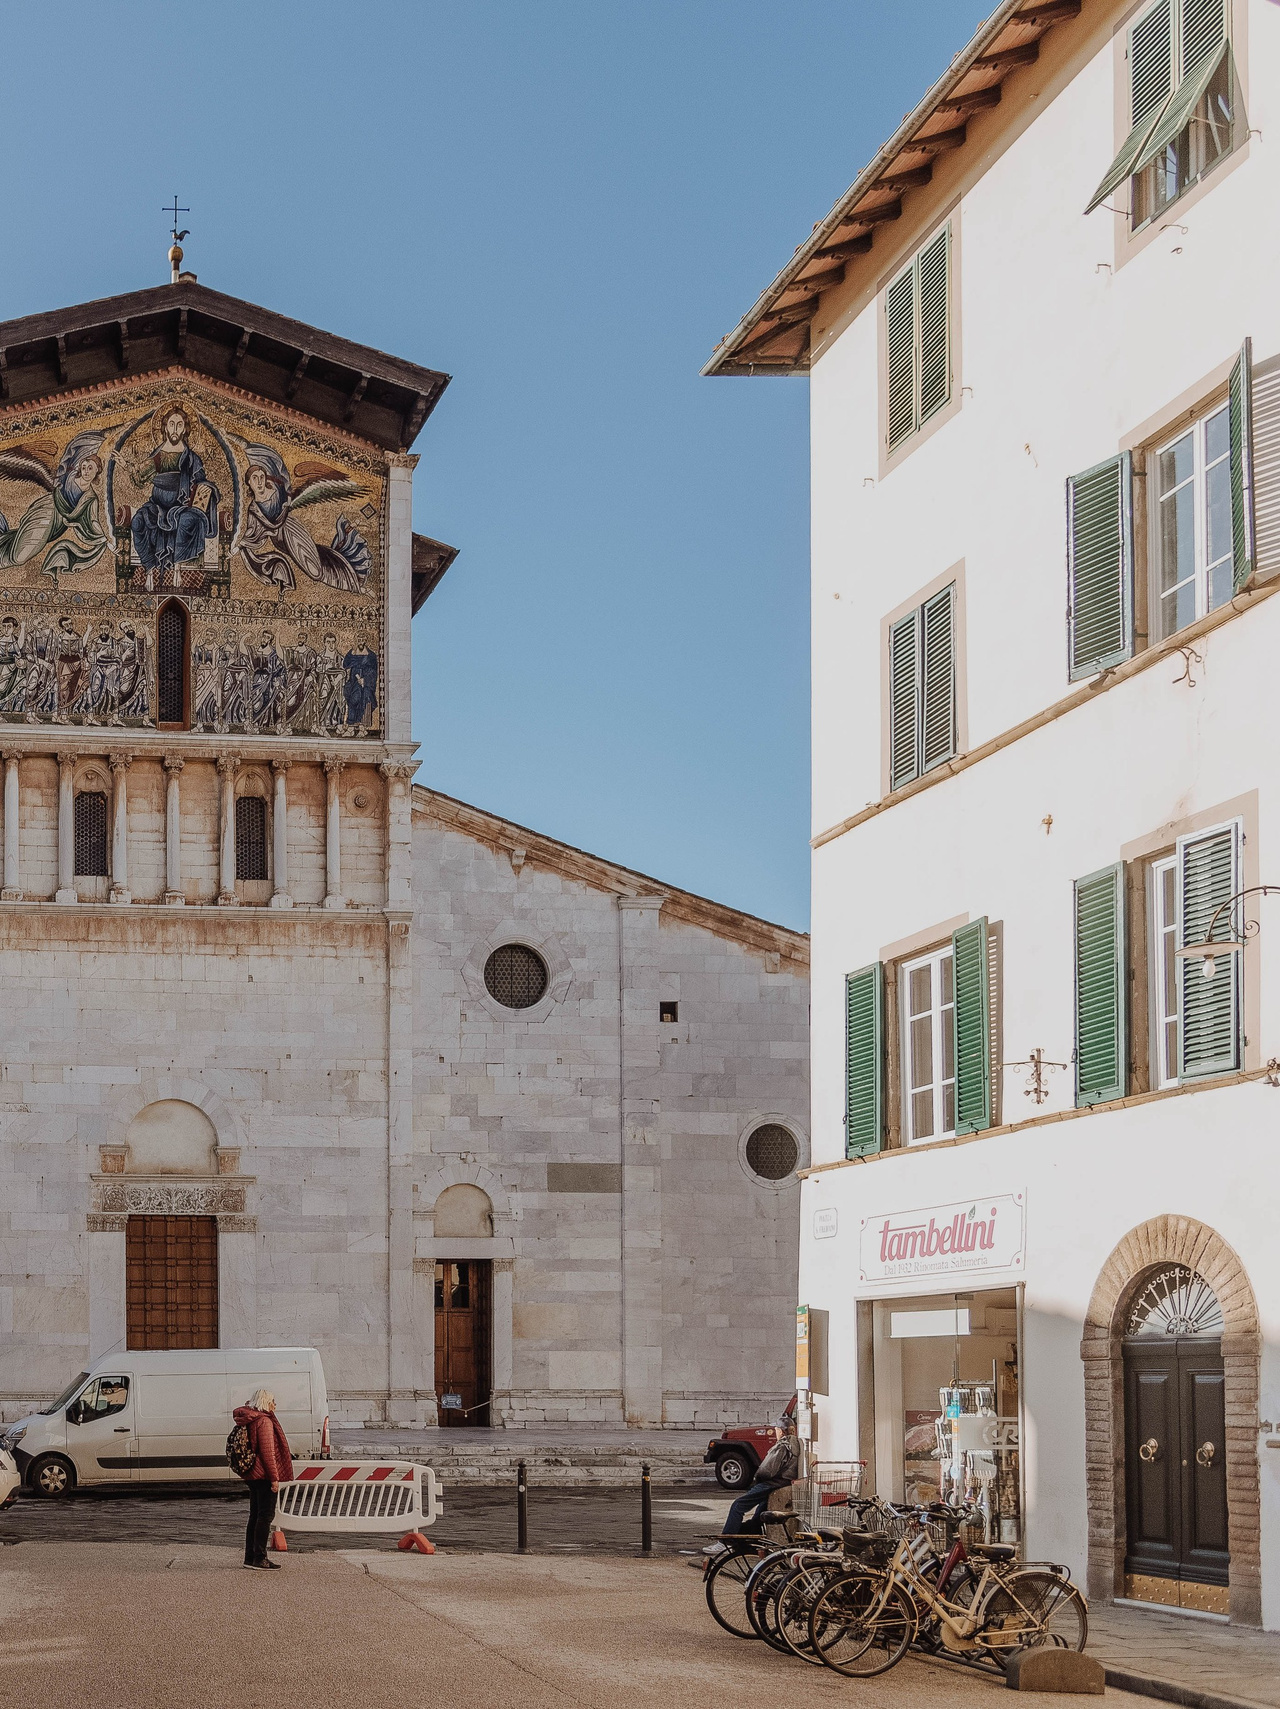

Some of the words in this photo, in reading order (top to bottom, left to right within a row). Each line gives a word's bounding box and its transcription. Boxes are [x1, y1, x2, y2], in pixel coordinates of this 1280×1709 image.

[884, 1264, 896, 1276] Dal
[913, 1261, 949, 1273] Rinomata
[951, 1254, 989, 1269] Salumeria
